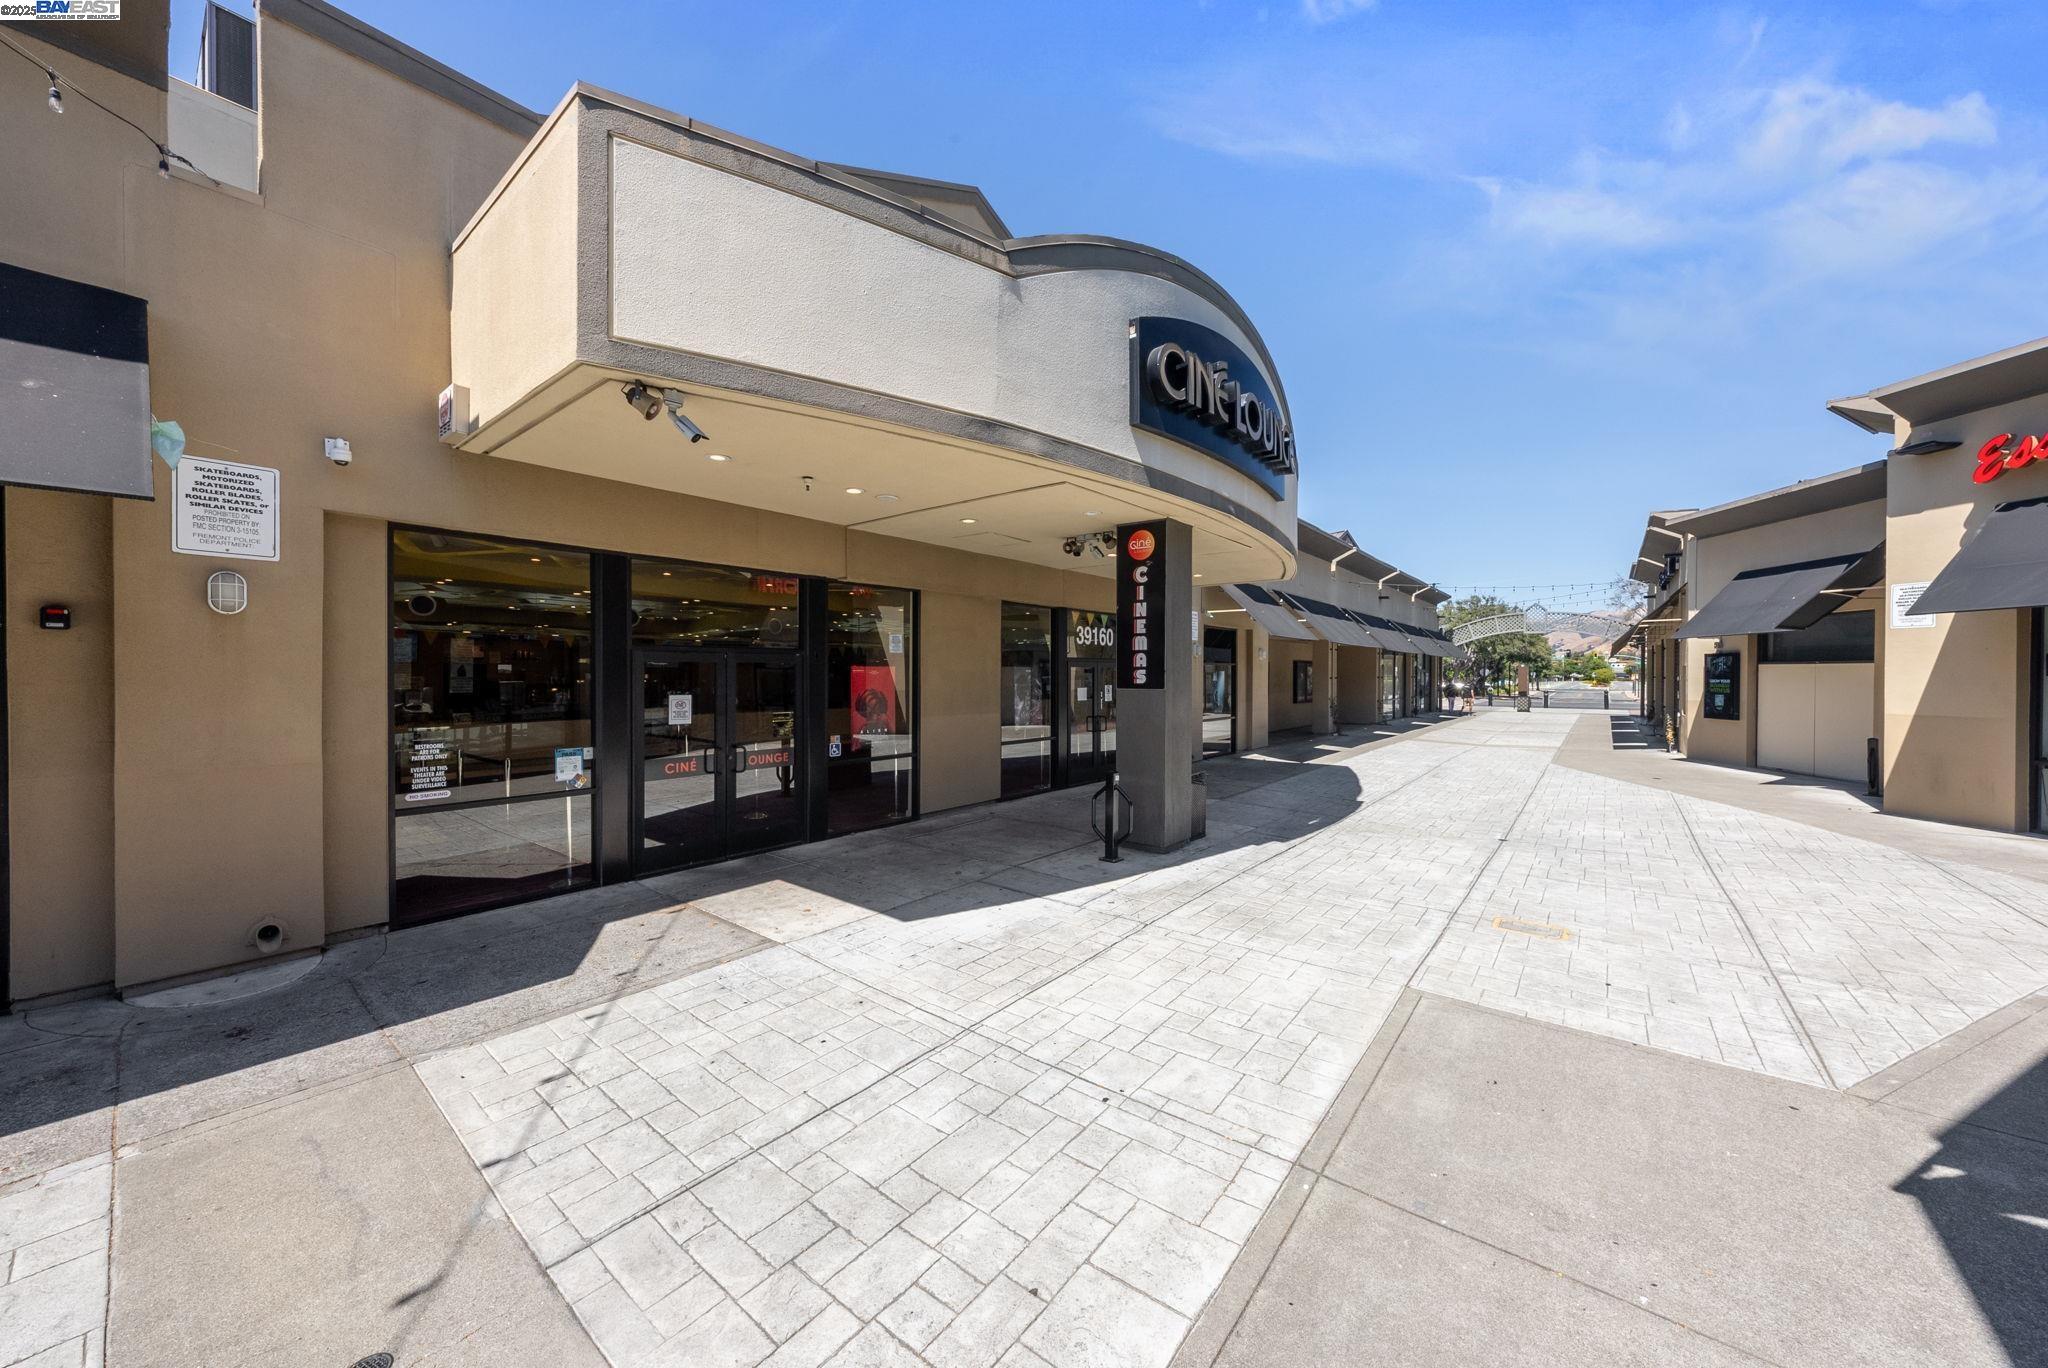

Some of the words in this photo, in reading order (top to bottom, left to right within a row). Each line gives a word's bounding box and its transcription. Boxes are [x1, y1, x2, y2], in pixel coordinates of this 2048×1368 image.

[1225, 379, 1294, 474] LOUNG
[194, 466, 262, 481] SKATEBOARDS,
[202, 474, 255, 486] MOTORIZED
[192, 487, 226, 497] ROLLER
[228, 491, 263, 502] BLADES,
[194, 480, 262, 495] SKATEBOARDS,
[185, 493, 220, 503] ROLLER
[222, 498, 257, 508] SKATES,
[189, 501, 226, 511] SIMILAR
[228, 506, 263, 515] DEVICES
[192, 514, 217, 523] POSTED
[218, 517, 250, 527] PROPERTY
[203, 509, 240, 519] PROHIBITED
[192, 521, 206, 530] FMC
[208, 523, 235, 533] SECTION
[192, 532, 231, 542] FREMONT
[233, 537, 261, 545] POLICE
[1132, 565, 1149, 685] CINEMAS
[1076, 626, 1114, 646] 39160
[664, 758, 697, 775] CINÉ
[747, 752, 789, 766] OUNGE
[411, 781, 447, 790] SURVEILLANCE
